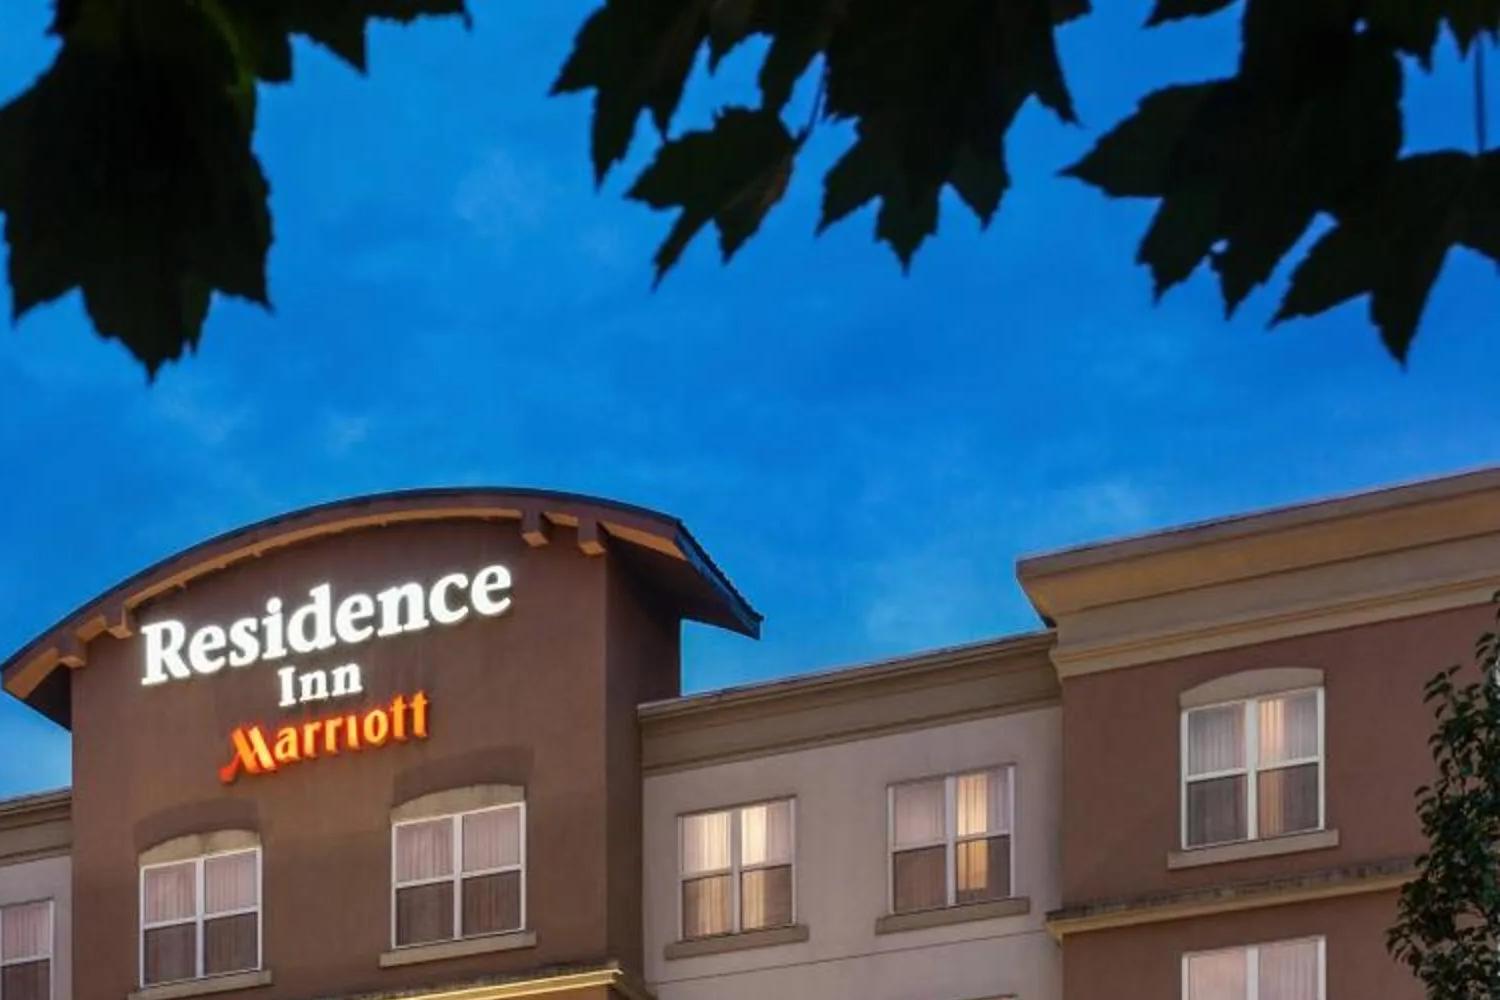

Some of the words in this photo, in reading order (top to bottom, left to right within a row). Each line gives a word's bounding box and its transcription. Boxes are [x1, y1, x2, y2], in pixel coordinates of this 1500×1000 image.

[141, 564, 512, 686] Residence
[278, 662, 362, 706] Inn
[219, 690, 429, 783] Marriott
